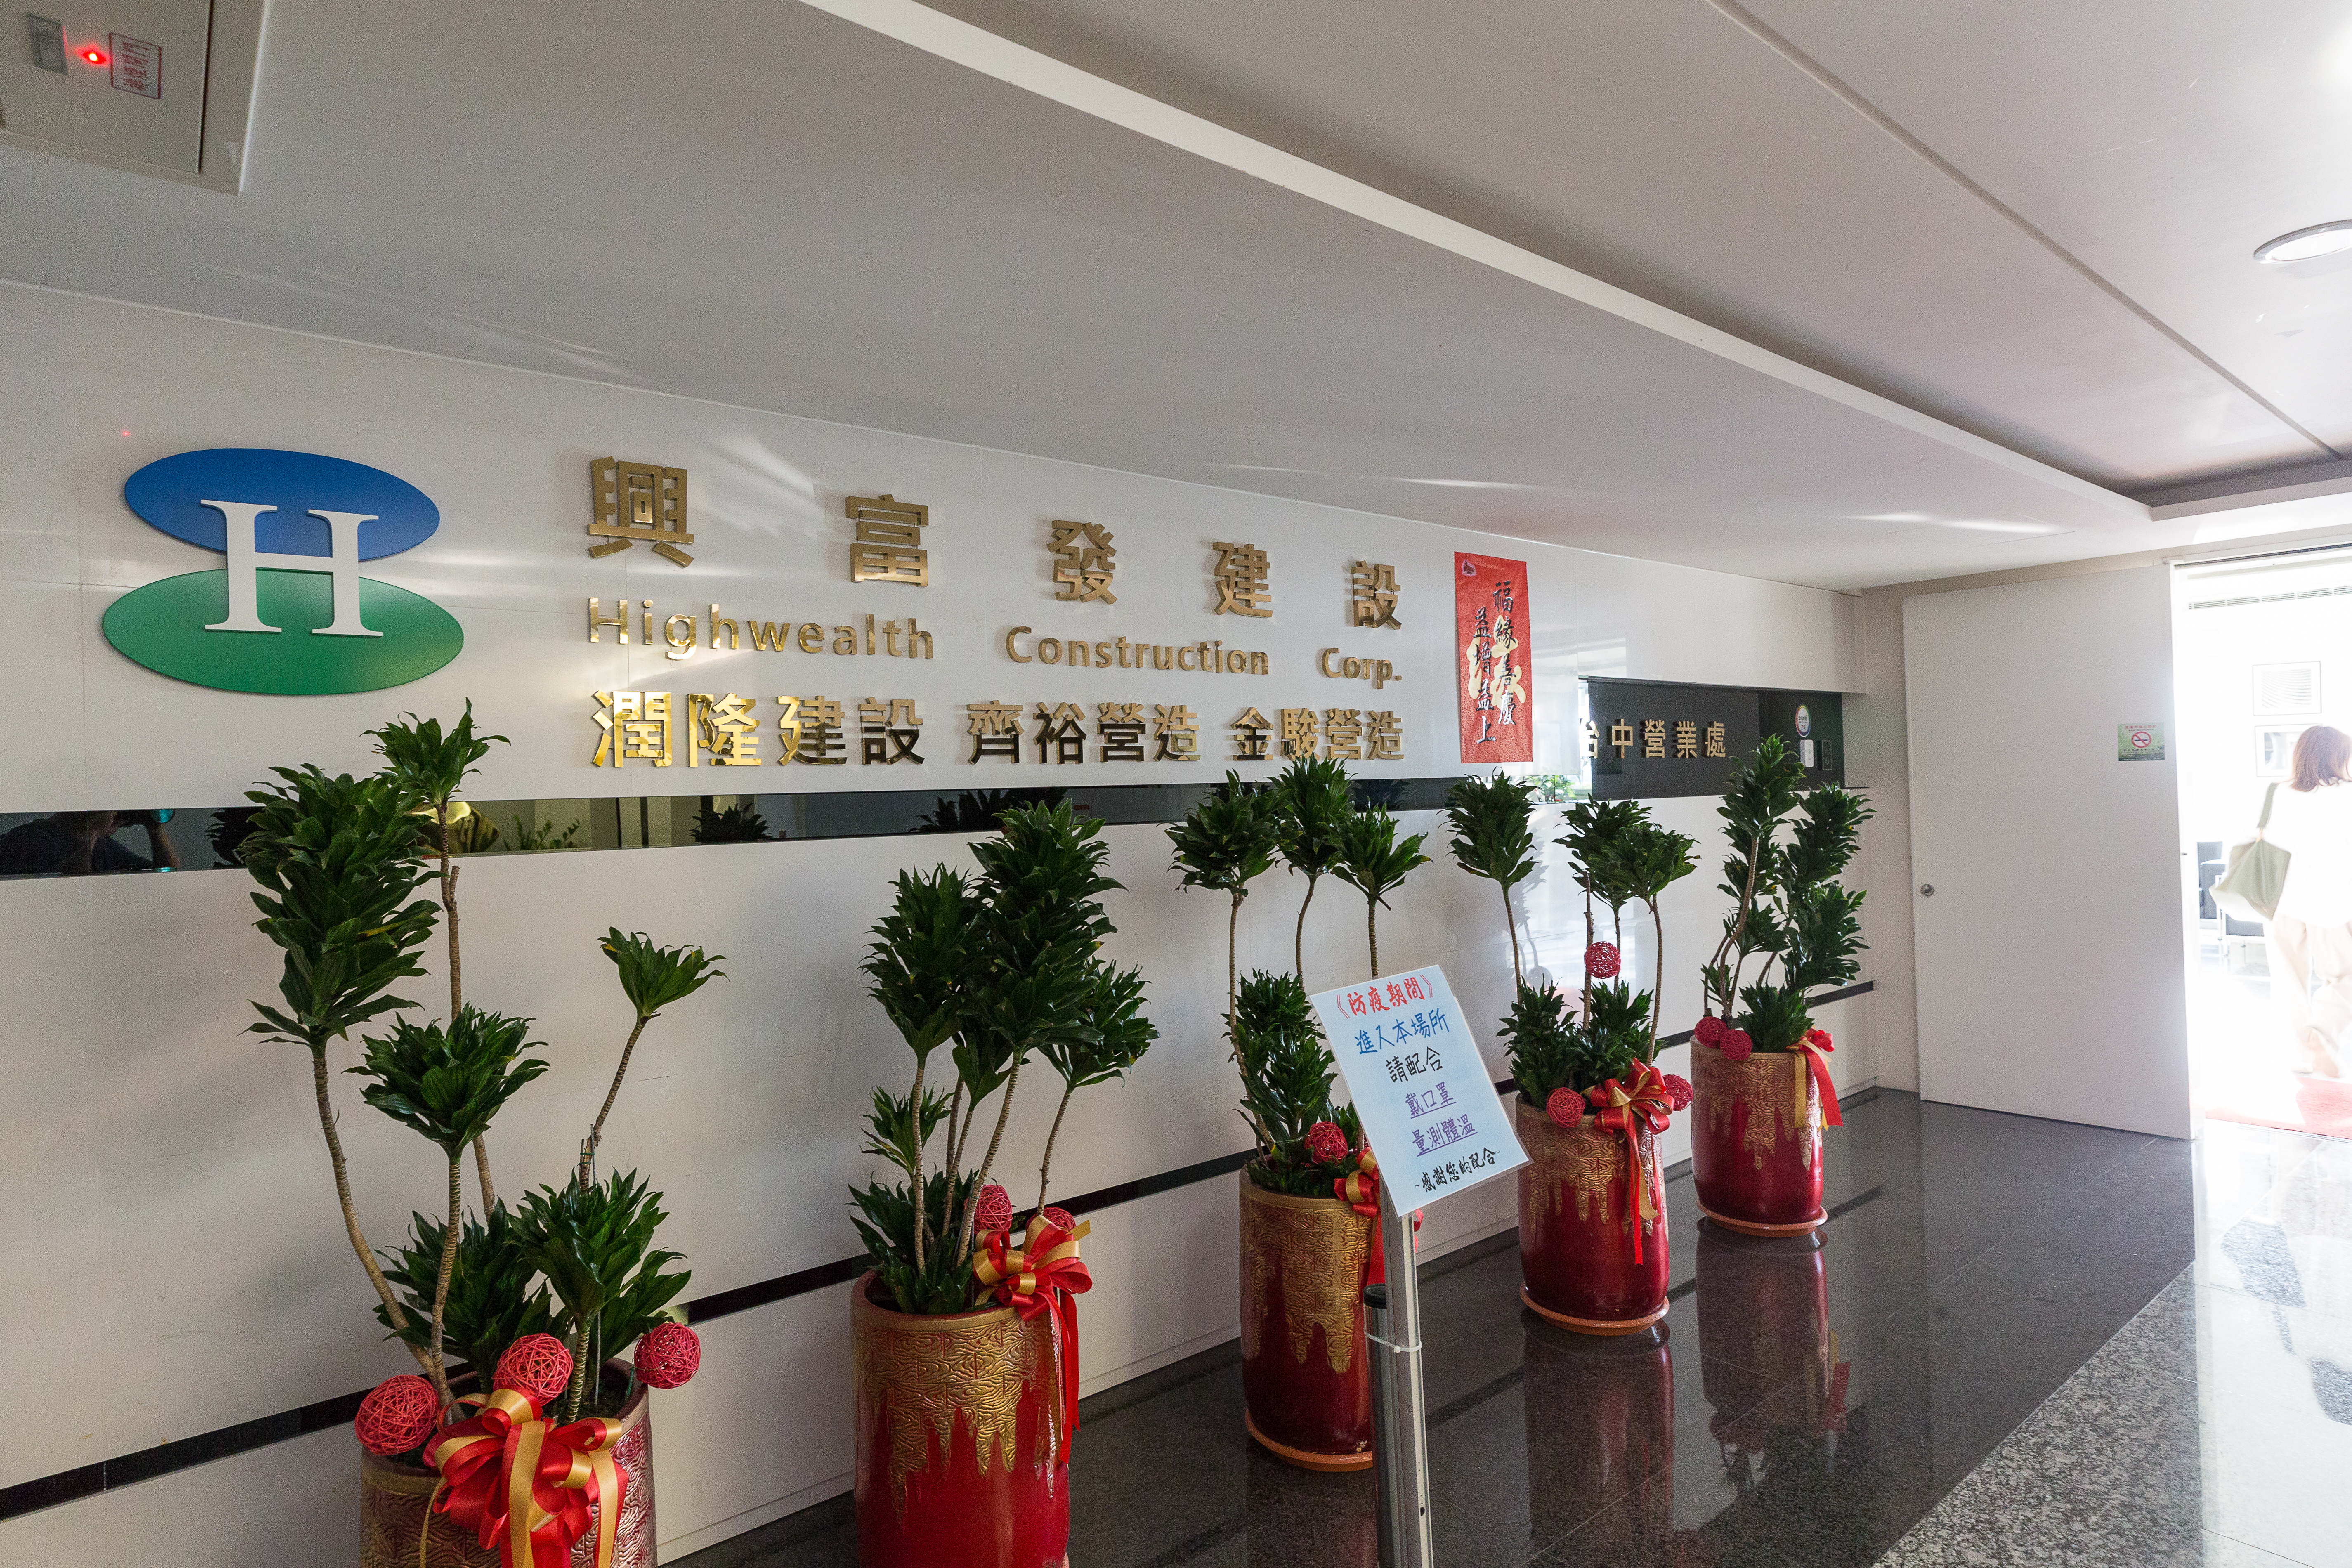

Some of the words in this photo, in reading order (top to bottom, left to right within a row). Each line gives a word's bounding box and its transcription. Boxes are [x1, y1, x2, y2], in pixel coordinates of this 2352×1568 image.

[201, 500, 383, 637] H
[588, 456, 1401, 630] 興富發建設
[588, 597, 933, 659] Highwealth
[1006, 626, 1269, 675] Construction
[1321, 647, 1402, 689] Corp.
[590, 690, 925, 767] 潤隆建設
[967, 700, 1200, 765] 齊裕營造
[1231, 707, 1404, 761] 金駿營造
[1386, 1046, 1443, 1082] 請配合
[1405, 1082, 1454, 1116] 戴口罩
[1412, 1114, 1476, 1155] 量測體溫
